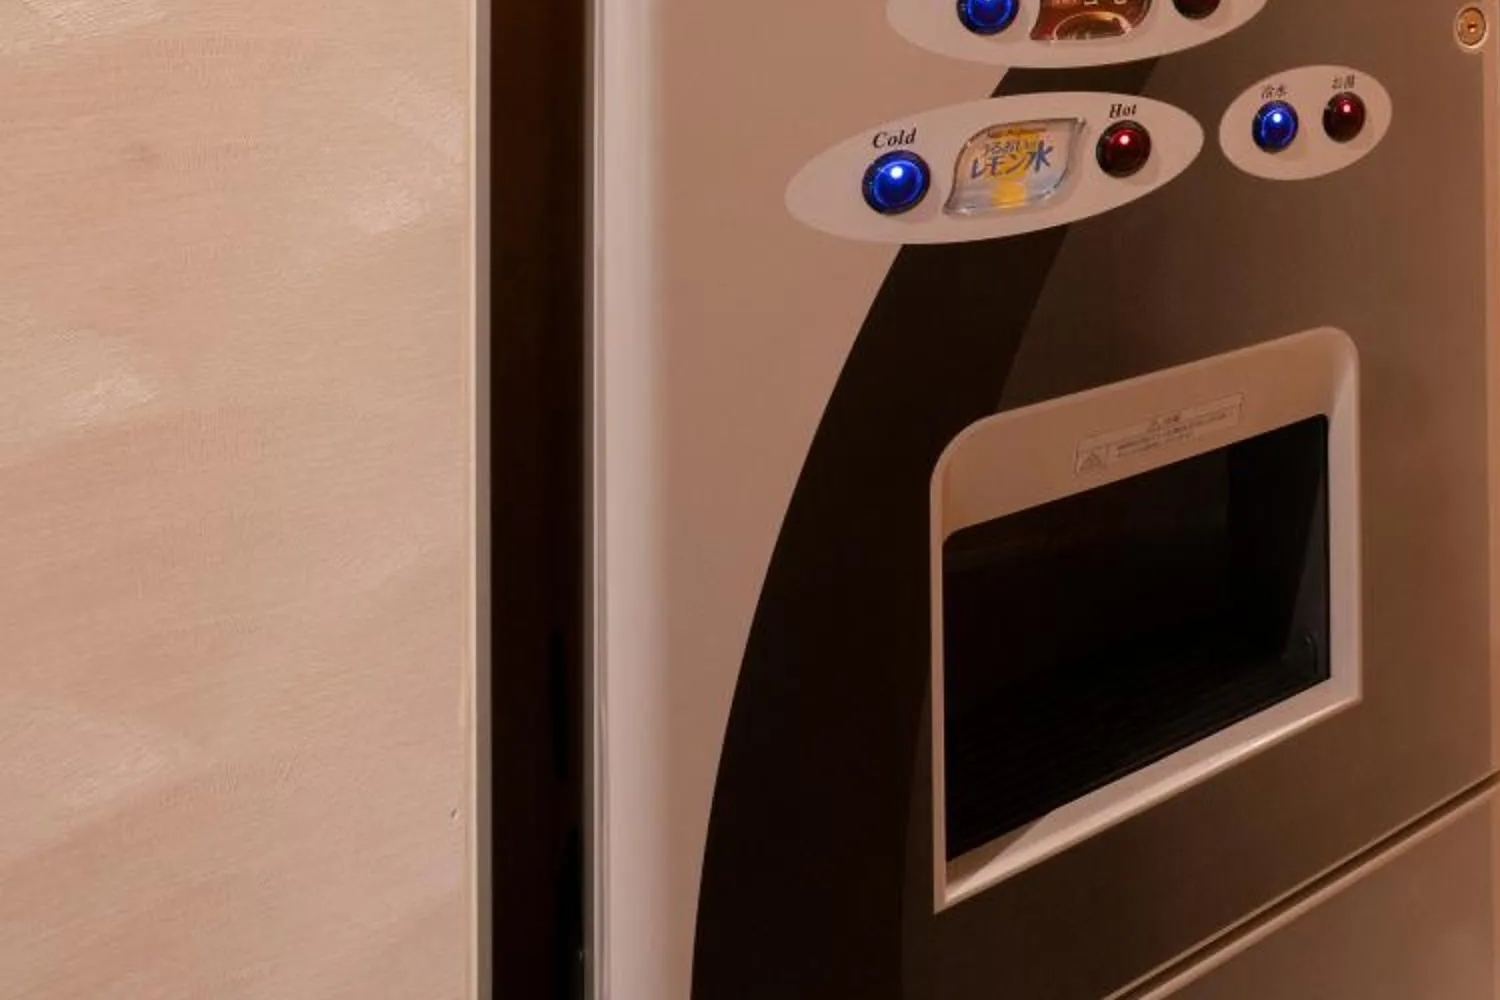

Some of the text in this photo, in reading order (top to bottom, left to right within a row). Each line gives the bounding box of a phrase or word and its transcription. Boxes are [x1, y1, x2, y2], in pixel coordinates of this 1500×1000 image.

[1109, 103, 1137, 119] Hot
[872, 127, 917, 149] Cold
[971, 140, 1054, 179] レモン水
